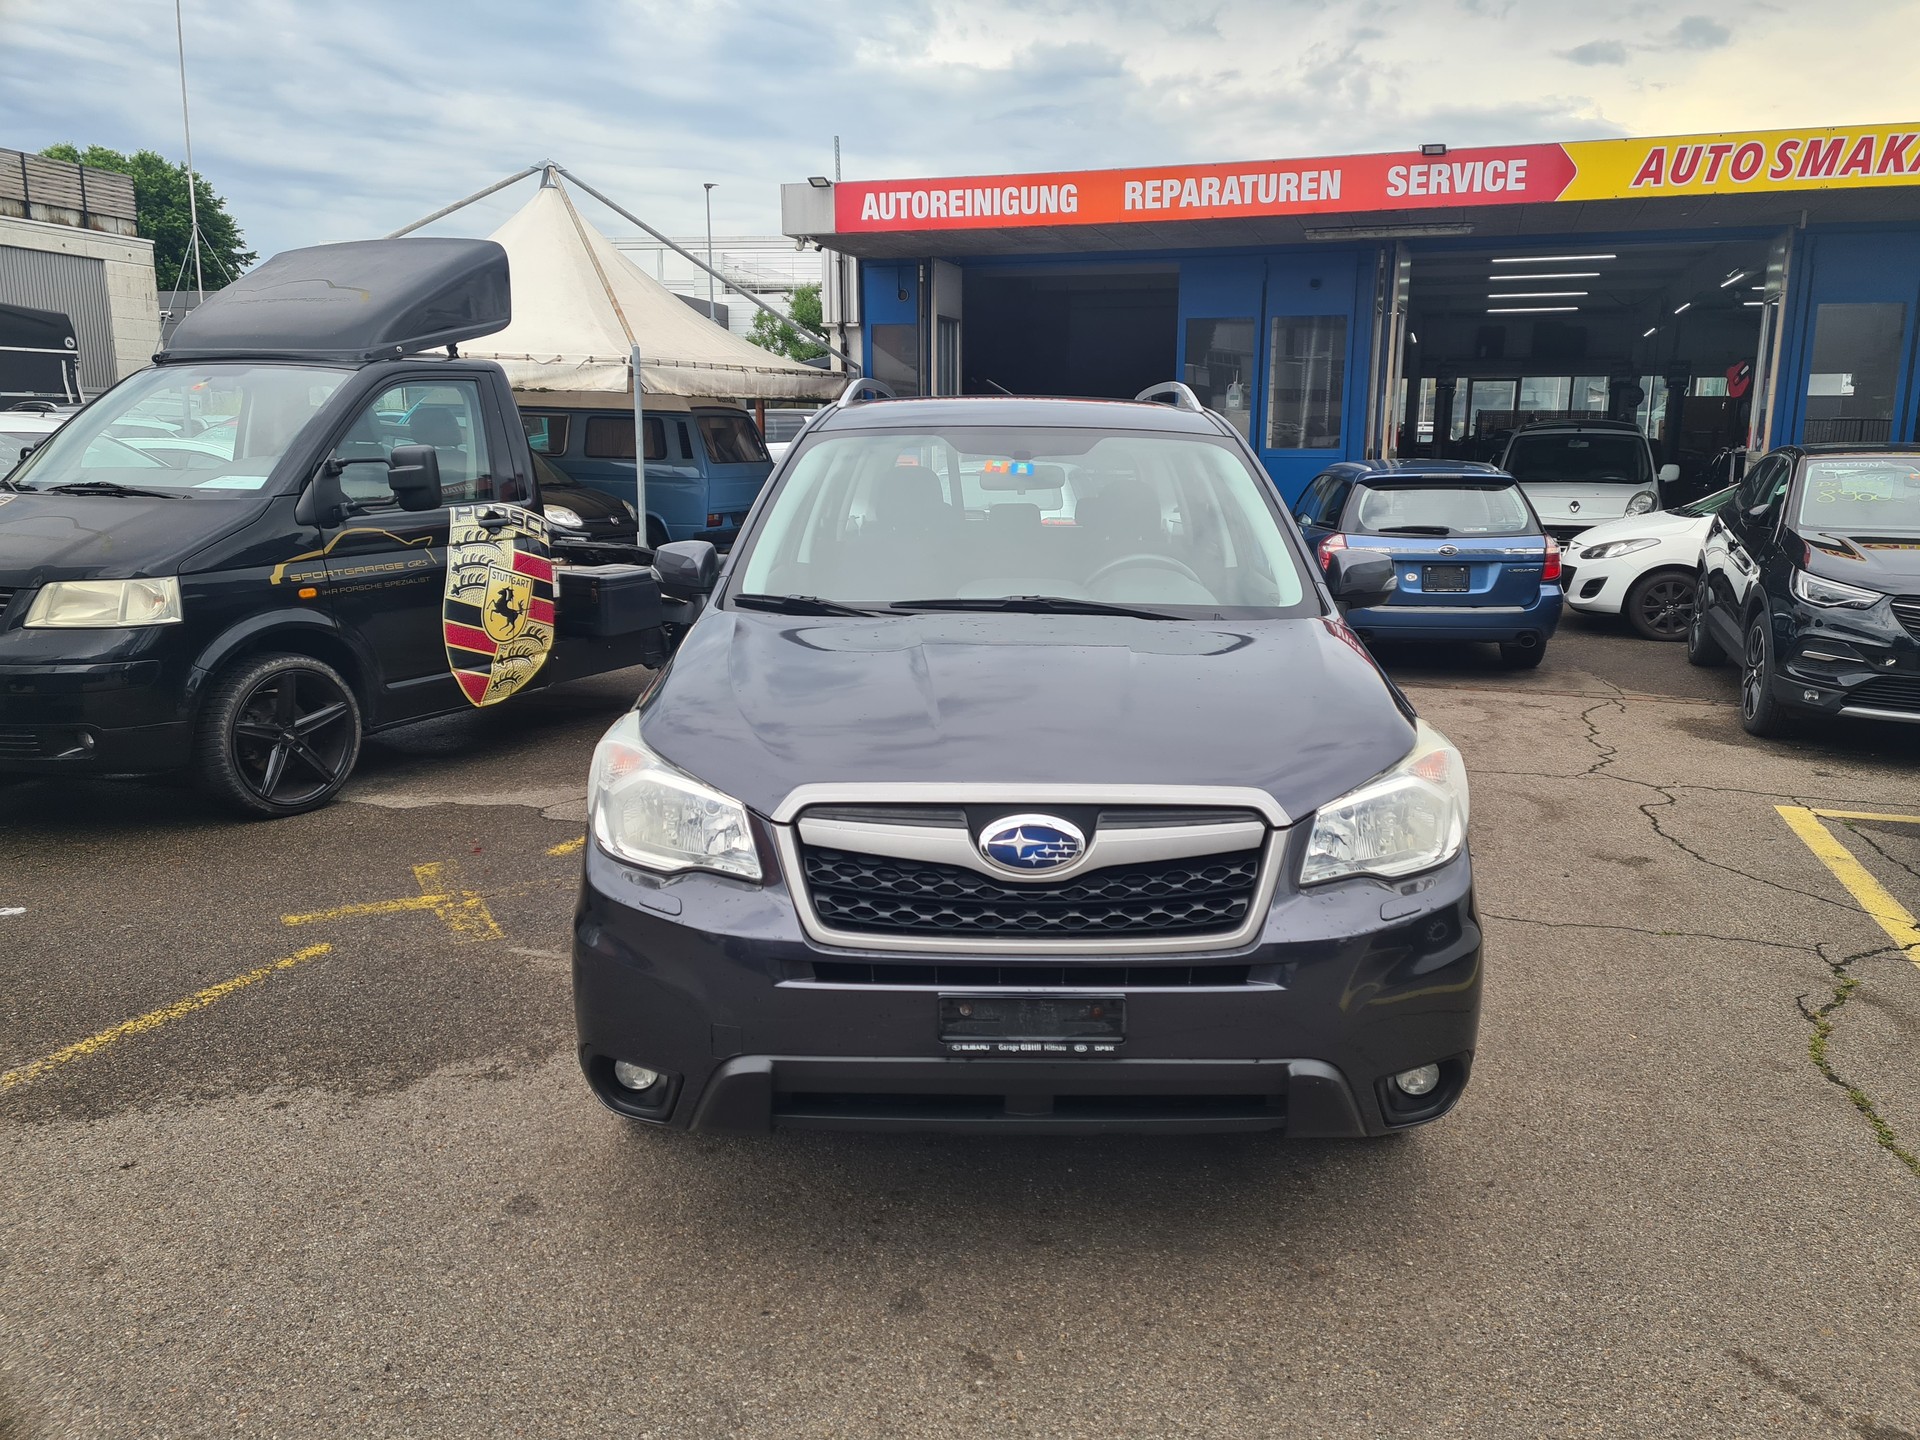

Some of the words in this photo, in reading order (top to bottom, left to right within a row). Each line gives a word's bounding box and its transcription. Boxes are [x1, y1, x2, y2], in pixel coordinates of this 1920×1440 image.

[1769, 134, 1920, 181] SMAK
[1124, 169, 1342, 210] REPARATUREN
[1386, 158, 1528, 197] SERVICE
[861, 184, 1078, 221] AUTOREINIGUNG
[289, 562, 405, 582] SPORTGARAGE
[321, 587, 339, 596] IHR
[339, 583, 383, 593] PORSCHE
[384, 576, 431, 588] SPEZIALIST
[491, 570, 531, 589] STUTTGART
[998, 1044, 1020, 1052] Garage
